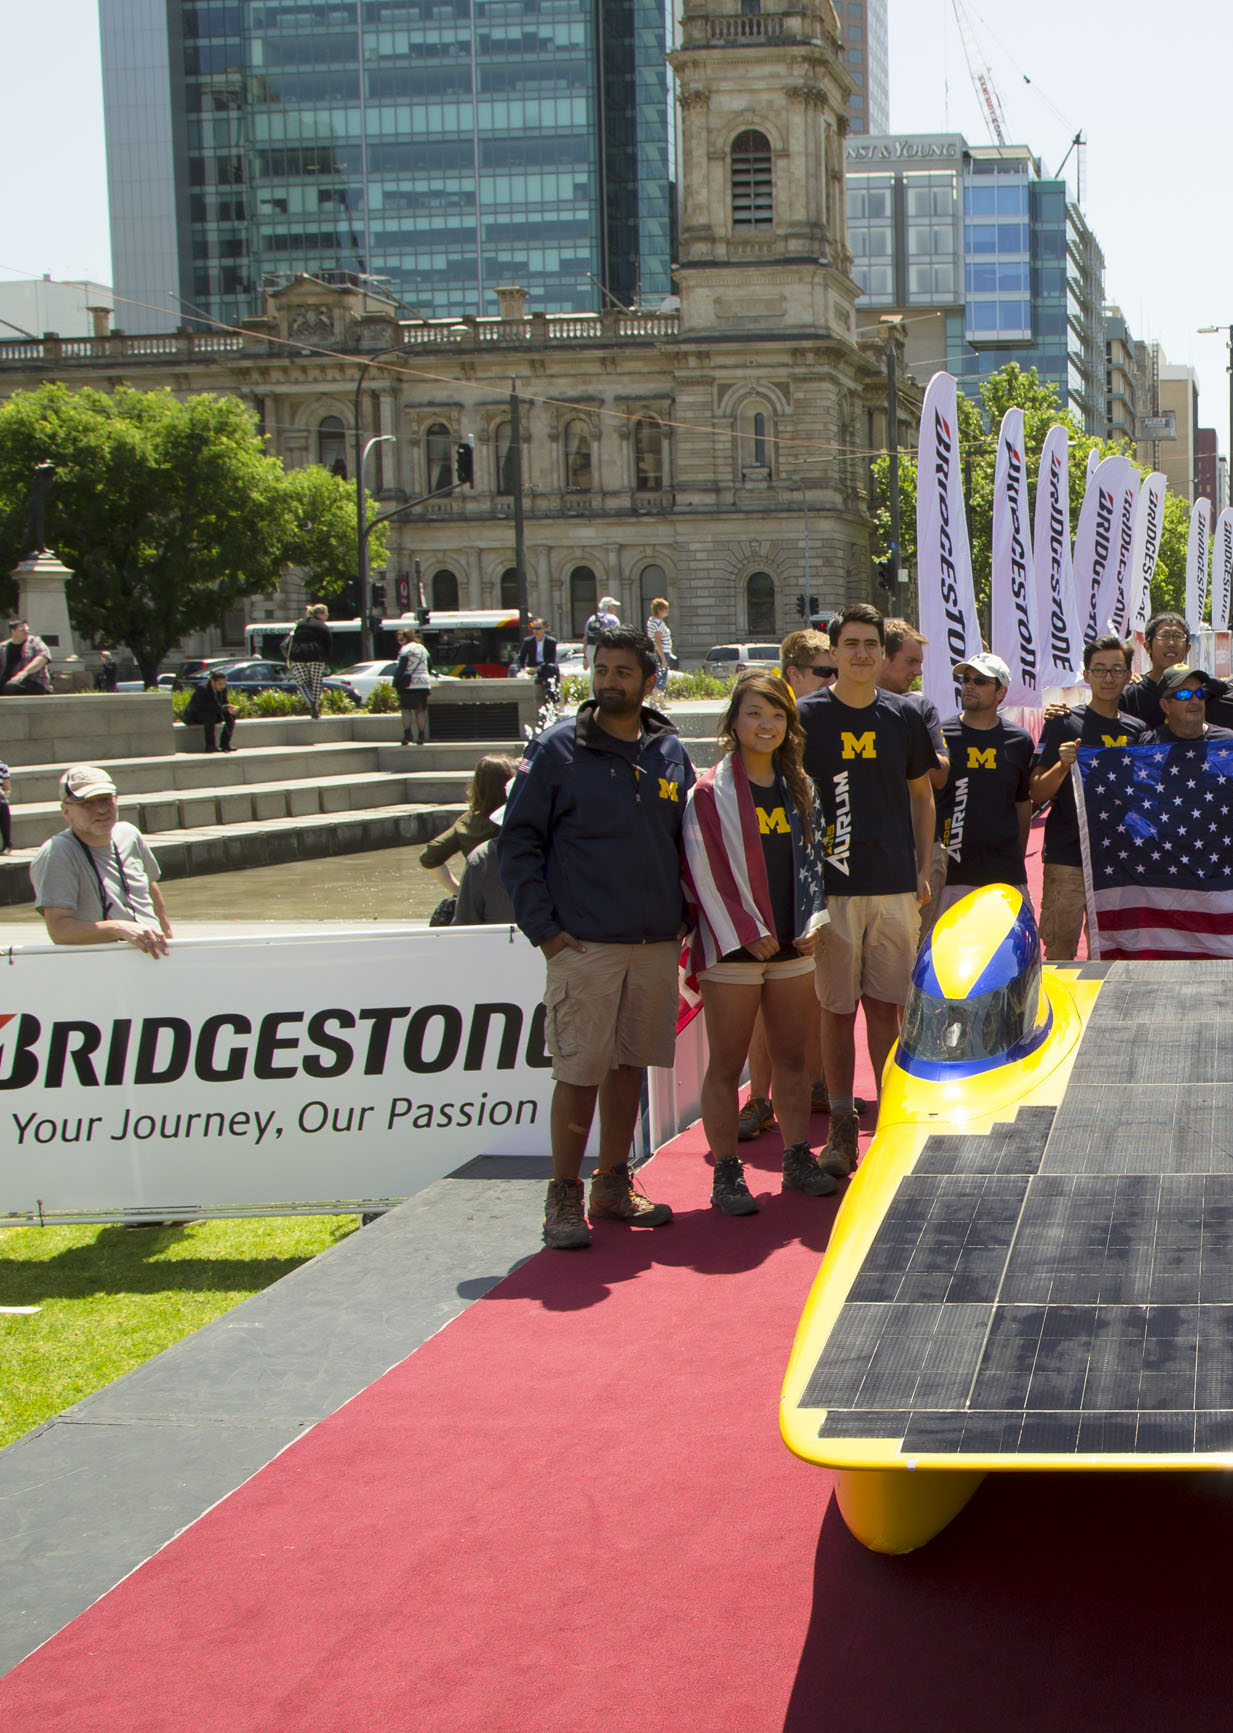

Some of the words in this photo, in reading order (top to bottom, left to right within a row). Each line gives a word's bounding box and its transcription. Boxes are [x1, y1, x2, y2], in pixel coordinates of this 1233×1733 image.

[846, 145, 877, 159] NST
[894, 139, 957, 158] YOUNG
[841, 731, 877, 759] M
[967, 747, 997, 769] M
[658, 778, 680, 802] M
[757, 807, 792, 835] M
[826, 770, 852, 877] AURUM
[946, 777, 969, 864] AURUM
[12, 1113, 102, 1145] Your
[110, 1108, 285, 1145] Journey,
[298, 1101, 375, 1134] Our
[387, 1092, 538, 1130] Passion
